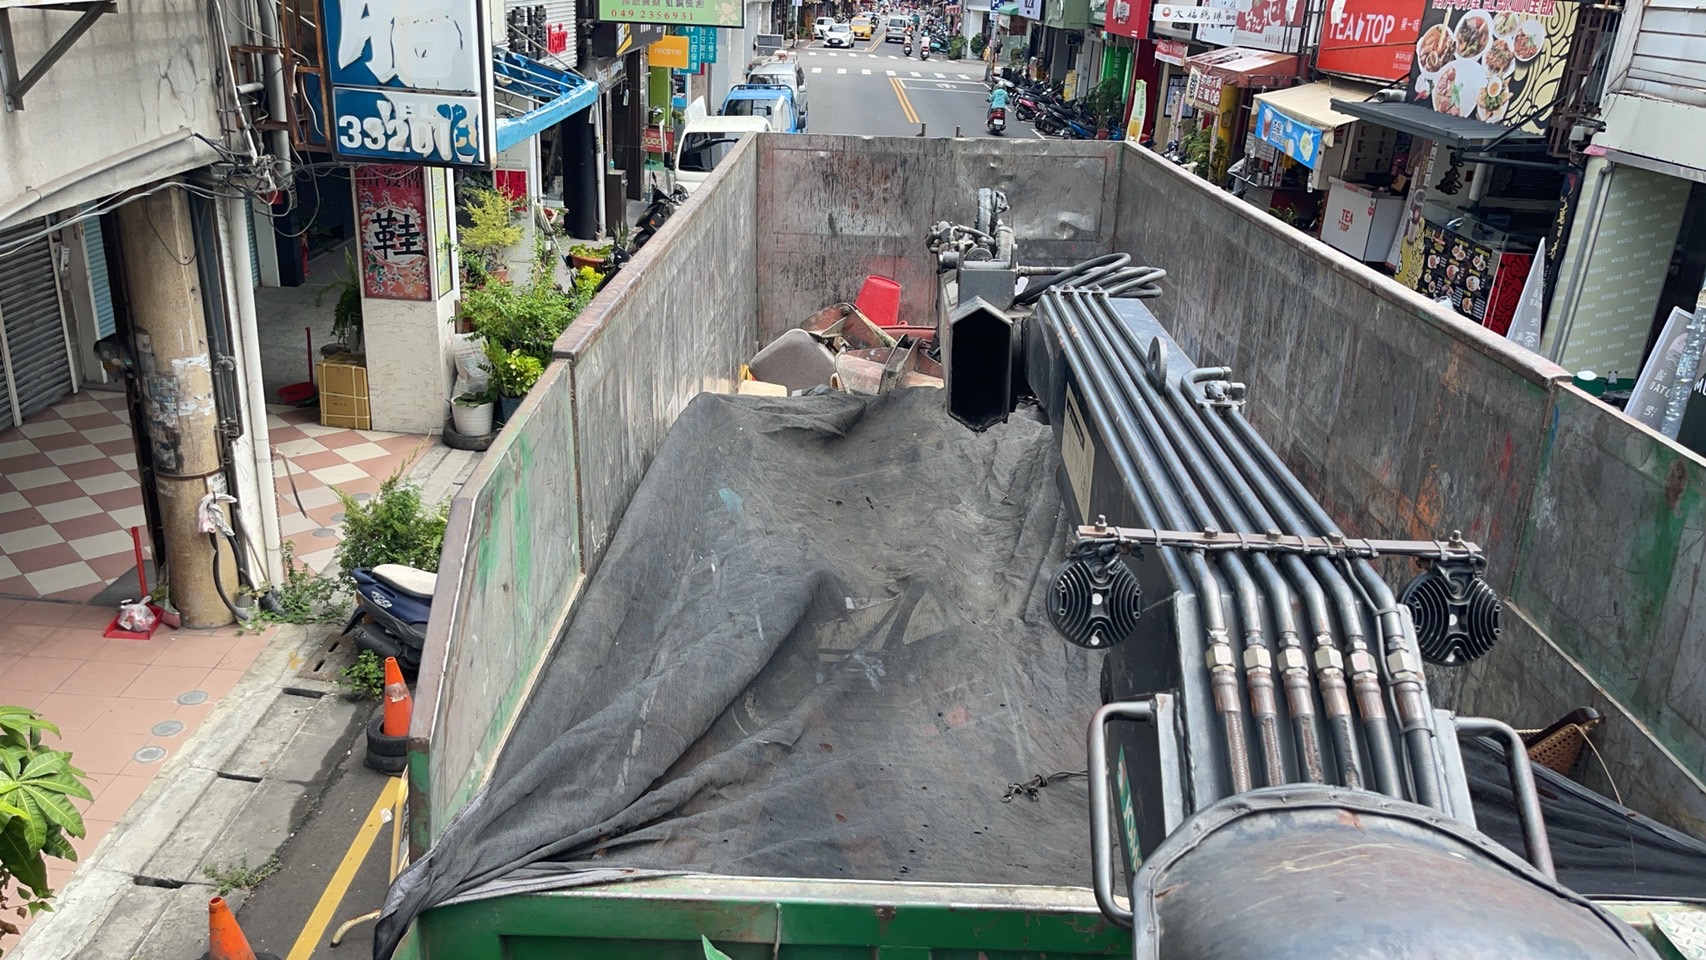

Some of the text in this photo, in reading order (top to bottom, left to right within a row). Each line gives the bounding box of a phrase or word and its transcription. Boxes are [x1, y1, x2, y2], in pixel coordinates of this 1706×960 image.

[611, 9, 694, 20] 049 2356931
[1329, 13, 1353, 40] EA
[1365, 14, 1395, 44] TOP
[1342, 209, 1354, 224] TEA
[370, 209, 426, 260] 鞋
[1649, 382, 1671, 398] OATL
